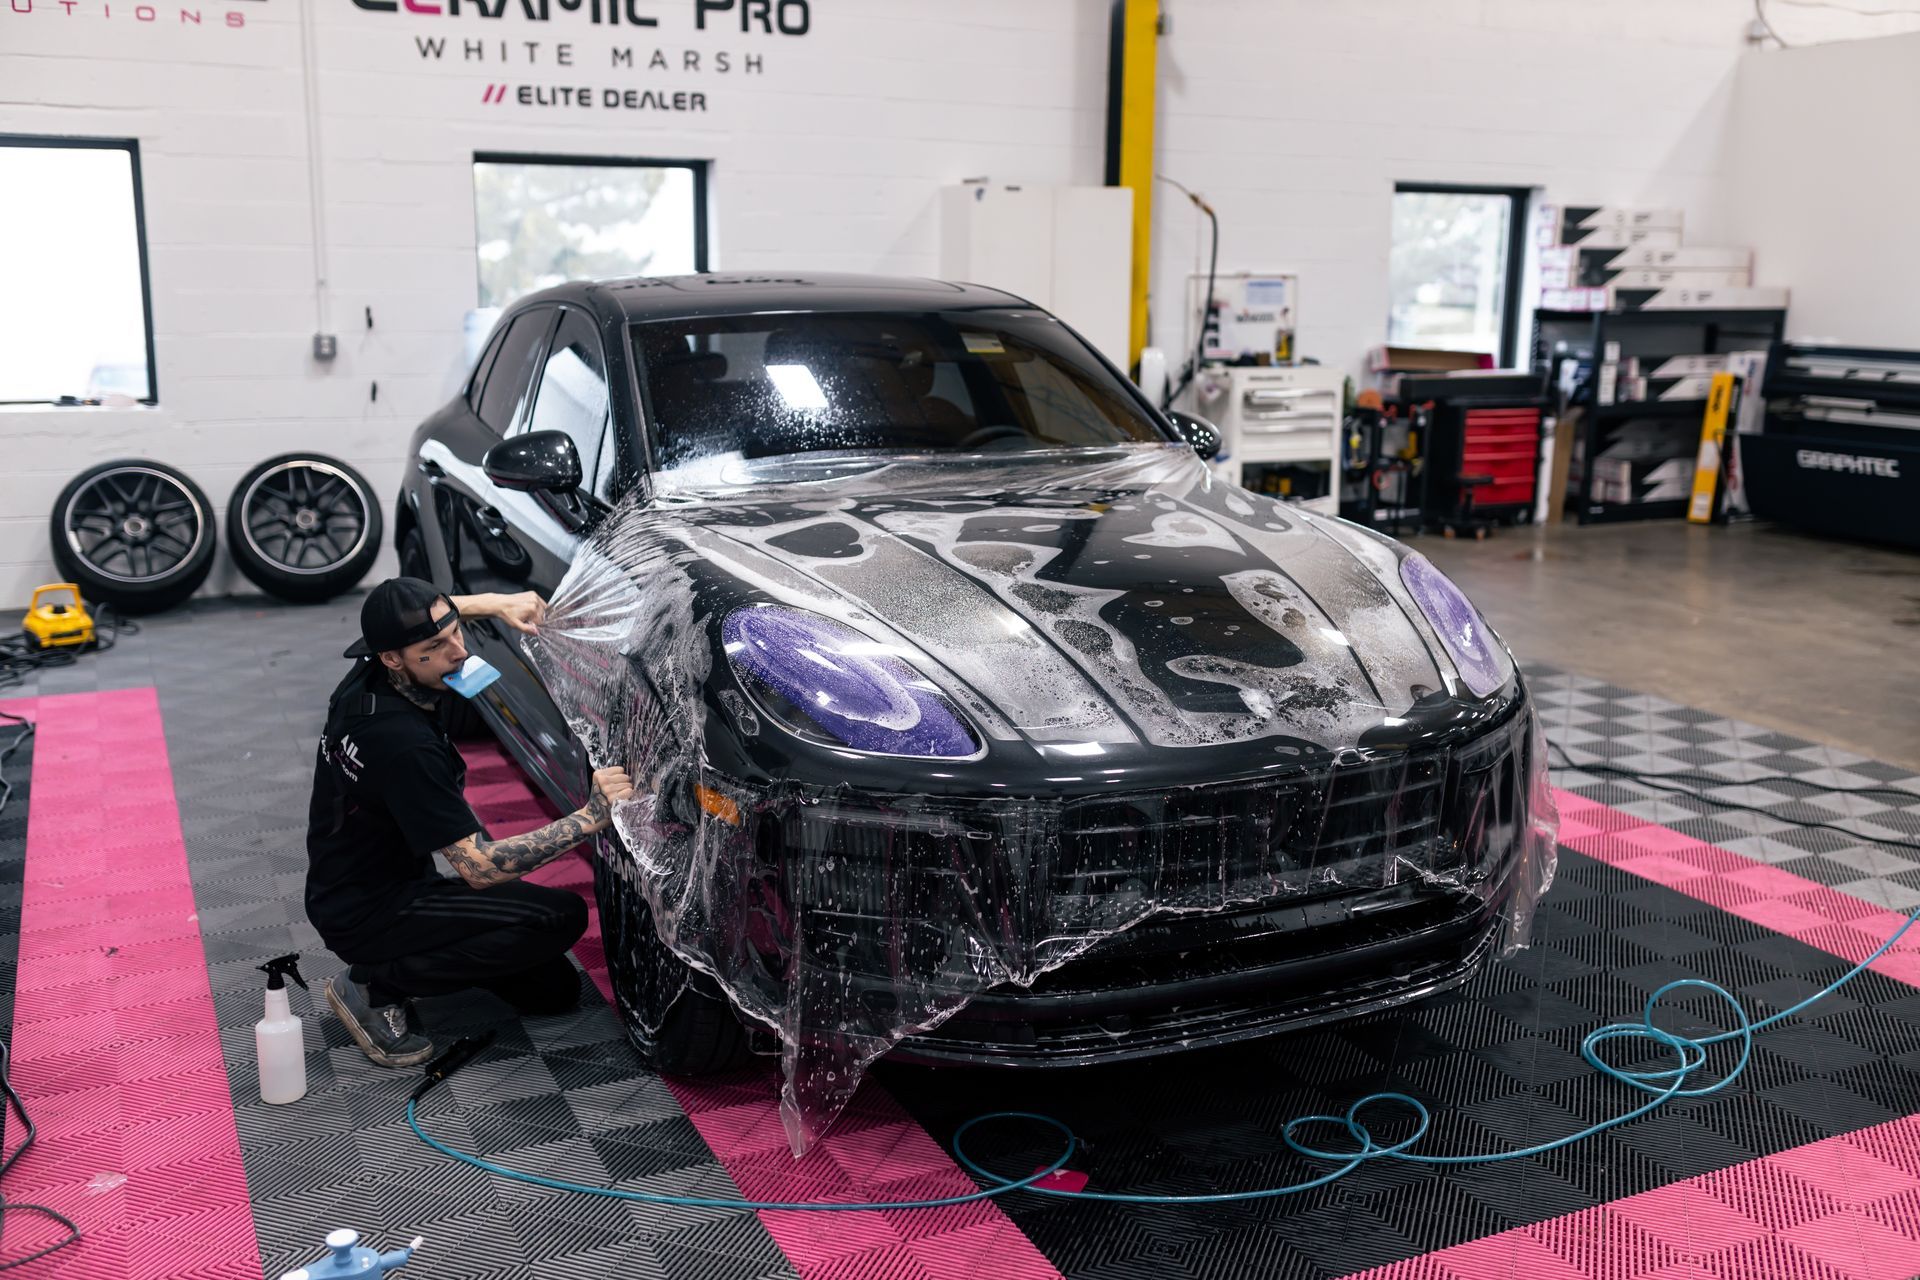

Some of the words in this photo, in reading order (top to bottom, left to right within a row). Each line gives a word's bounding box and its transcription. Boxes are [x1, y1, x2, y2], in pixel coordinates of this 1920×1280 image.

[351, 0, 658, 27] AMIC
[695, 0, 810, 36] PRO
[415, 36, 574, 66] WHITE
[611, 48, 765, 74] MARSH
[517, 85, 593, 107] ELITE
[604, 89, 708, 112] DEALER
[1796, 449, 1900, 478] GRAPHTEC
